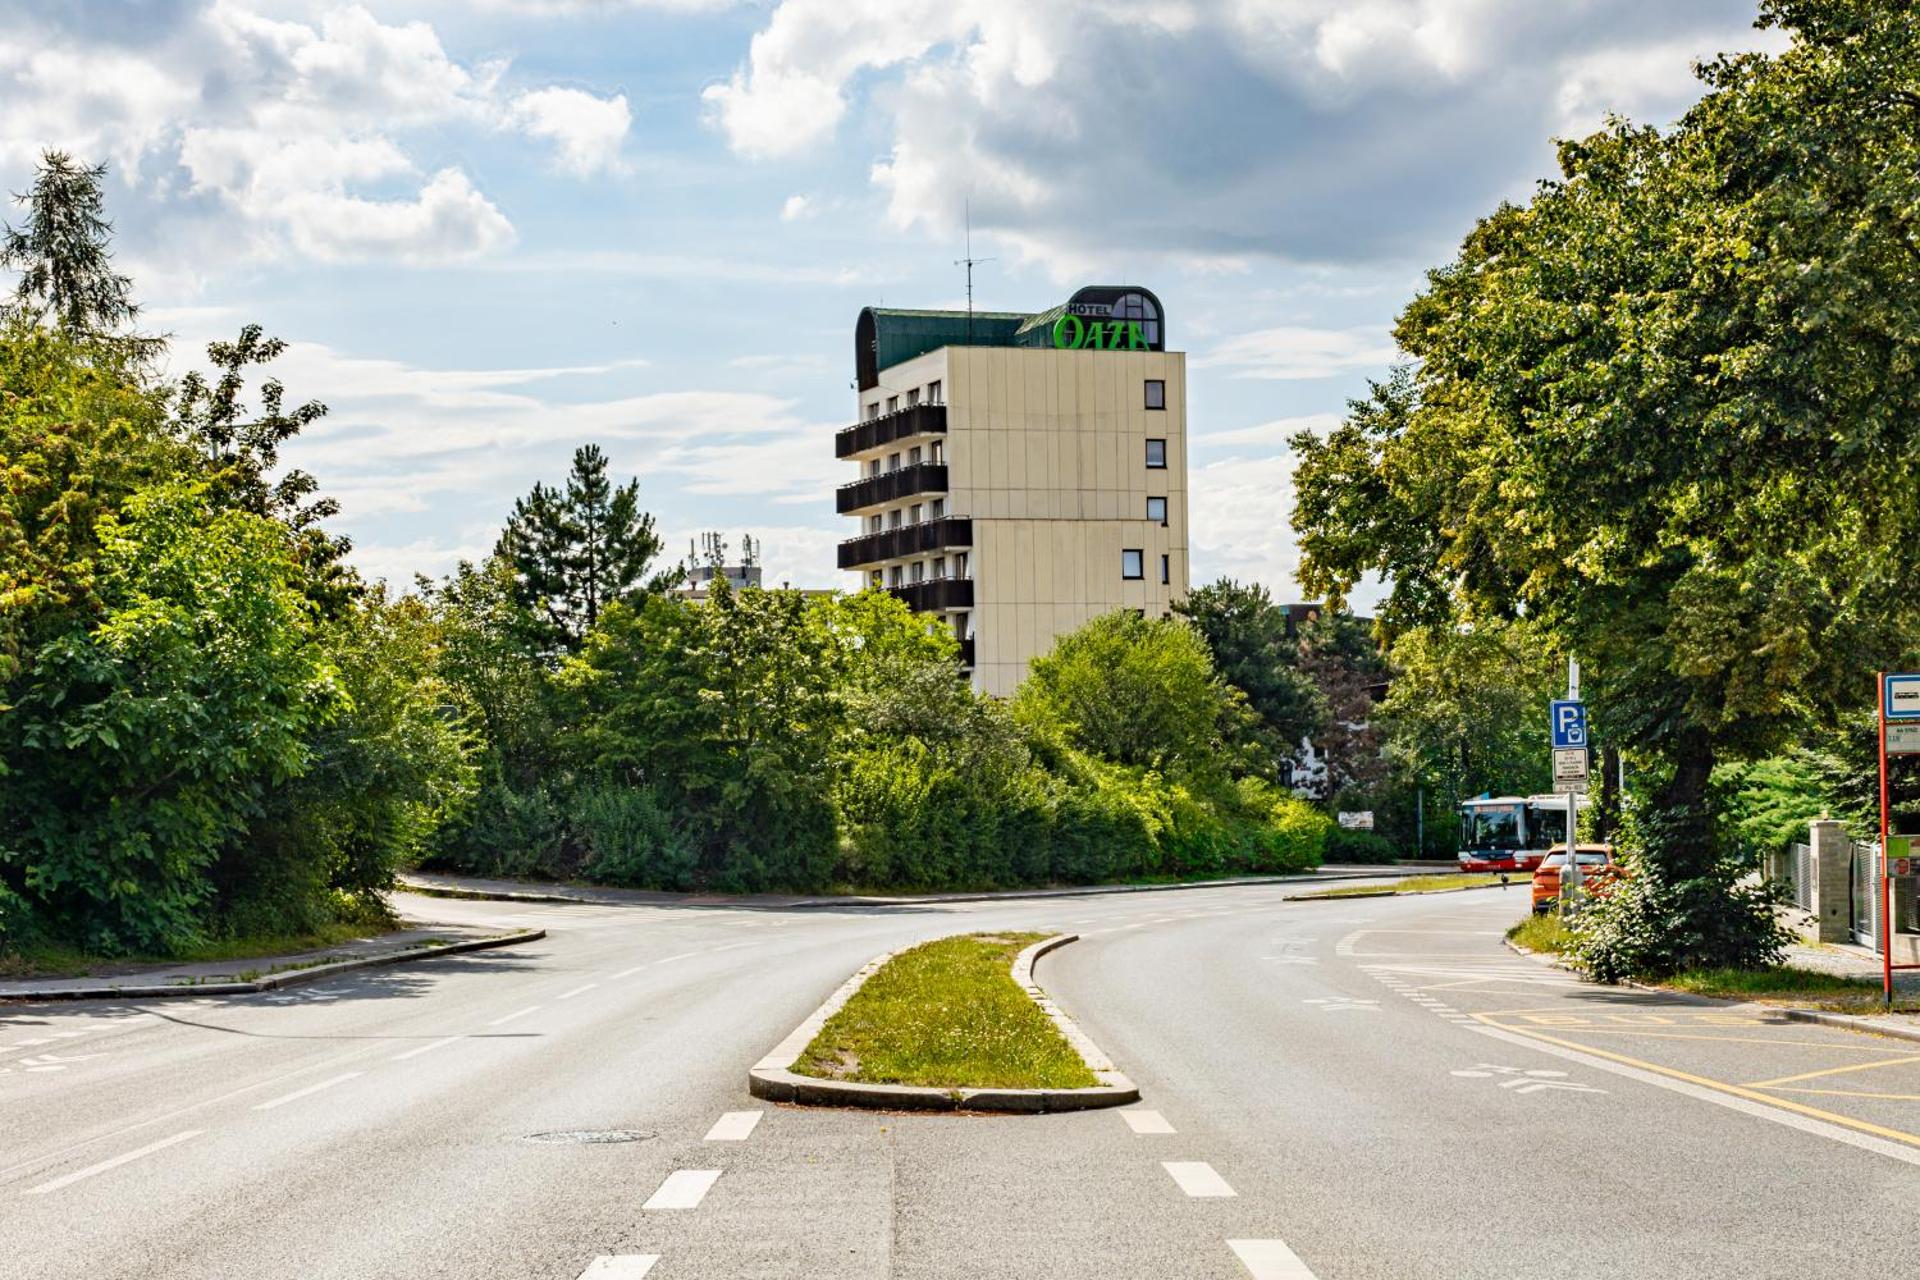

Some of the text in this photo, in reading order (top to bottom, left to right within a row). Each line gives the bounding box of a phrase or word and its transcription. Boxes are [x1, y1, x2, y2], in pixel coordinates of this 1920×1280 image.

[1068, 303, 1111, 315] HOTEL
[1558, 706, 1578, 733] P
[1519, 1015, 1762, 1025] BUS
